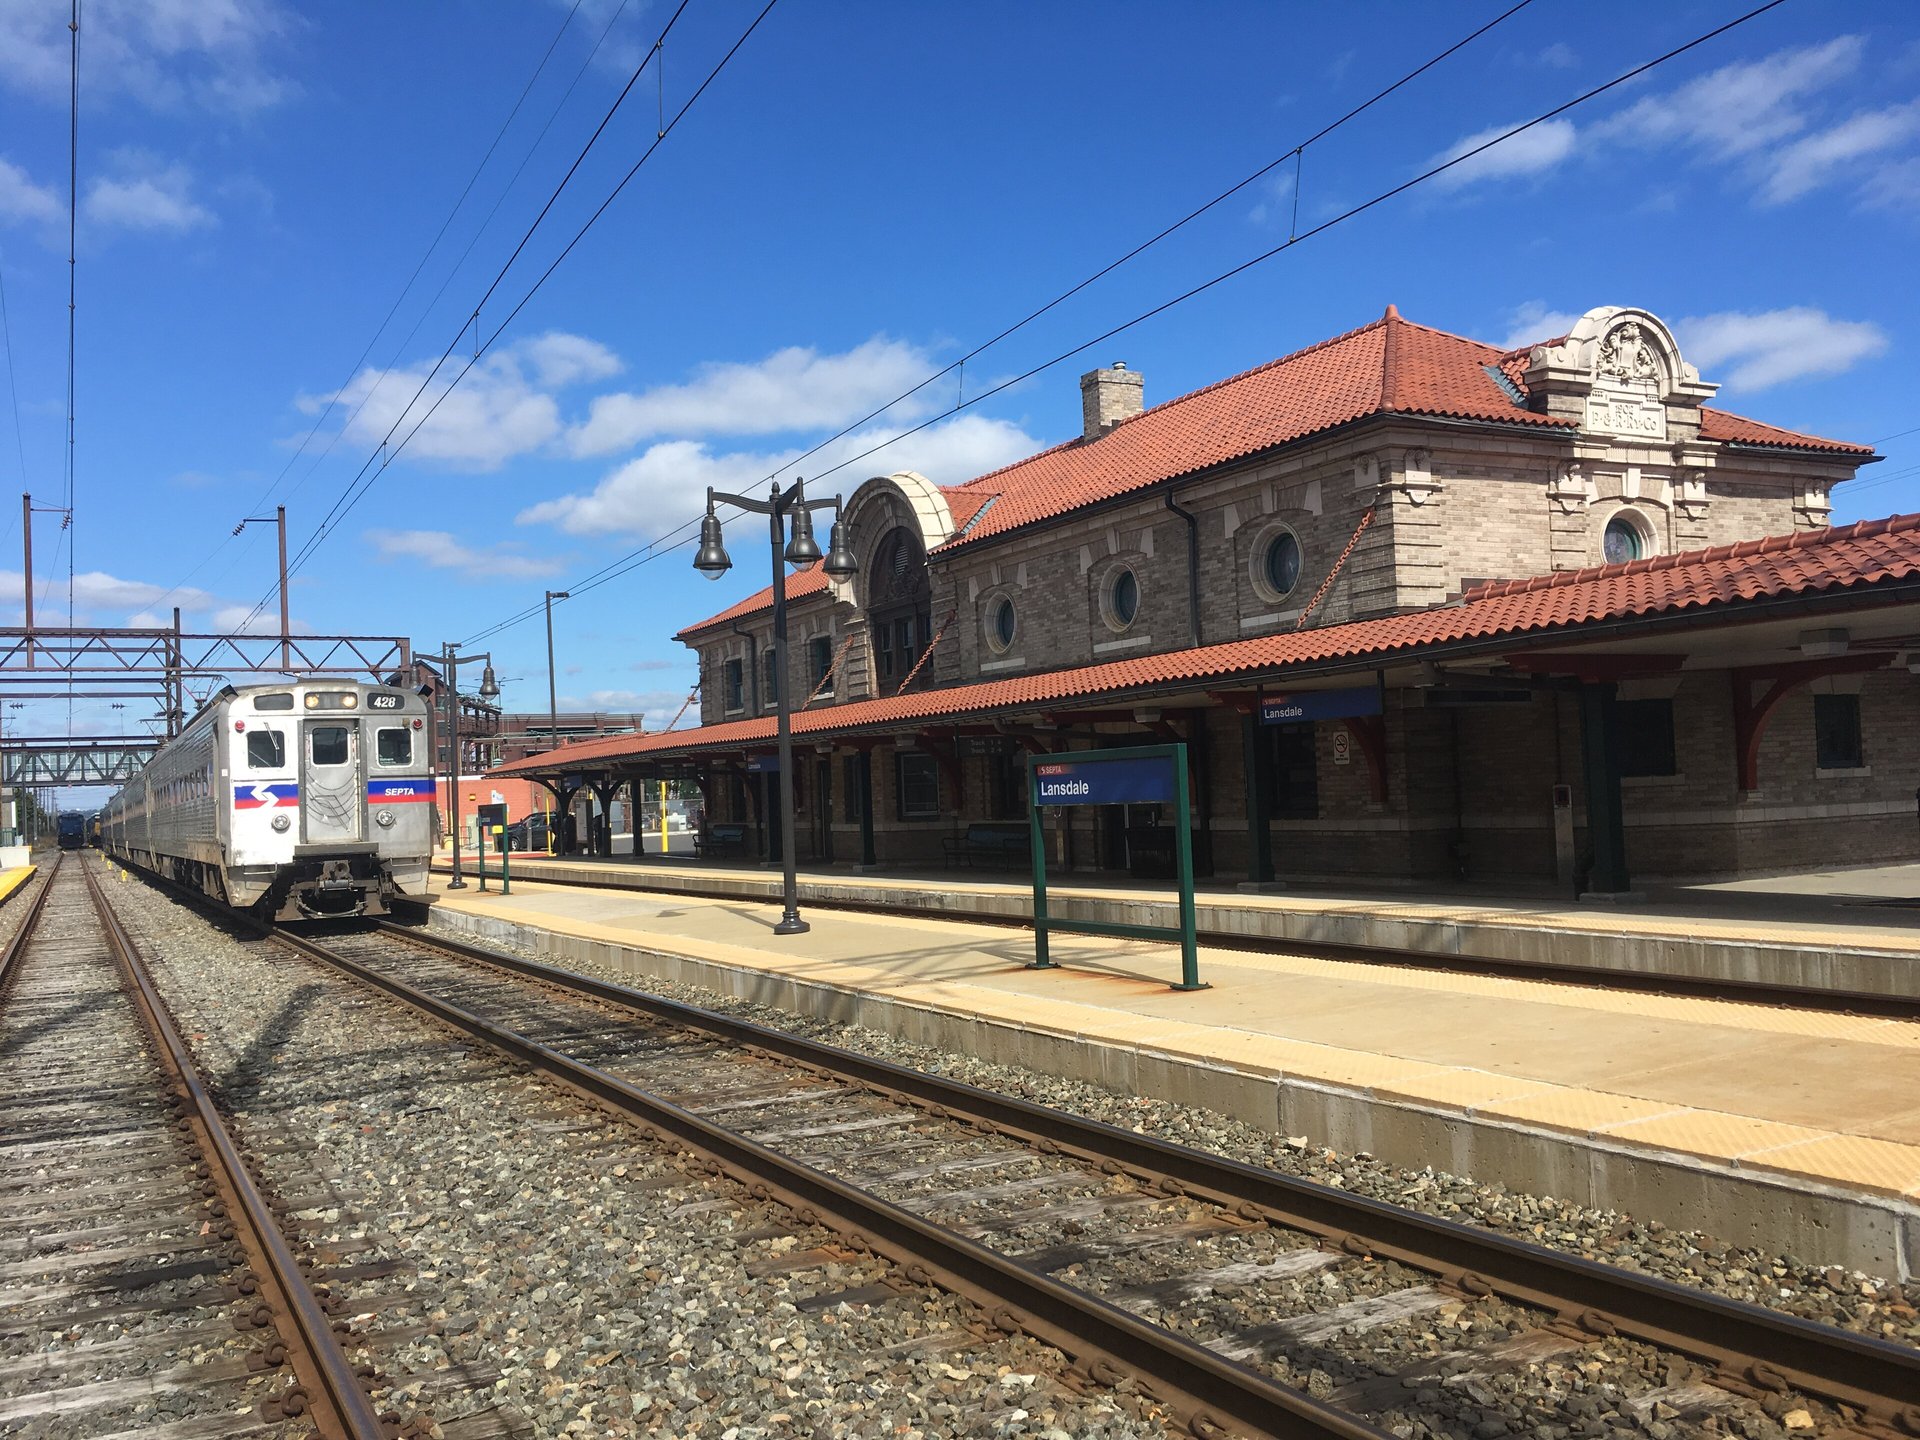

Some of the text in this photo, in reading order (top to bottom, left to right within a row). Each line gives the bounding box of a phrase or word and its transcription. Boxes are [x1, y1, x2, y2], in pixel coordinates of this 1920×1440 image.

[373, 696, 396, 708] 428
[1264, 706, 1303, 719] Lansdale
[1046, 765, 1062, 774] SEPTA
[385, 787, 415, 796] SEPTA
[1041, 779, 1089, 796] Lansdale
